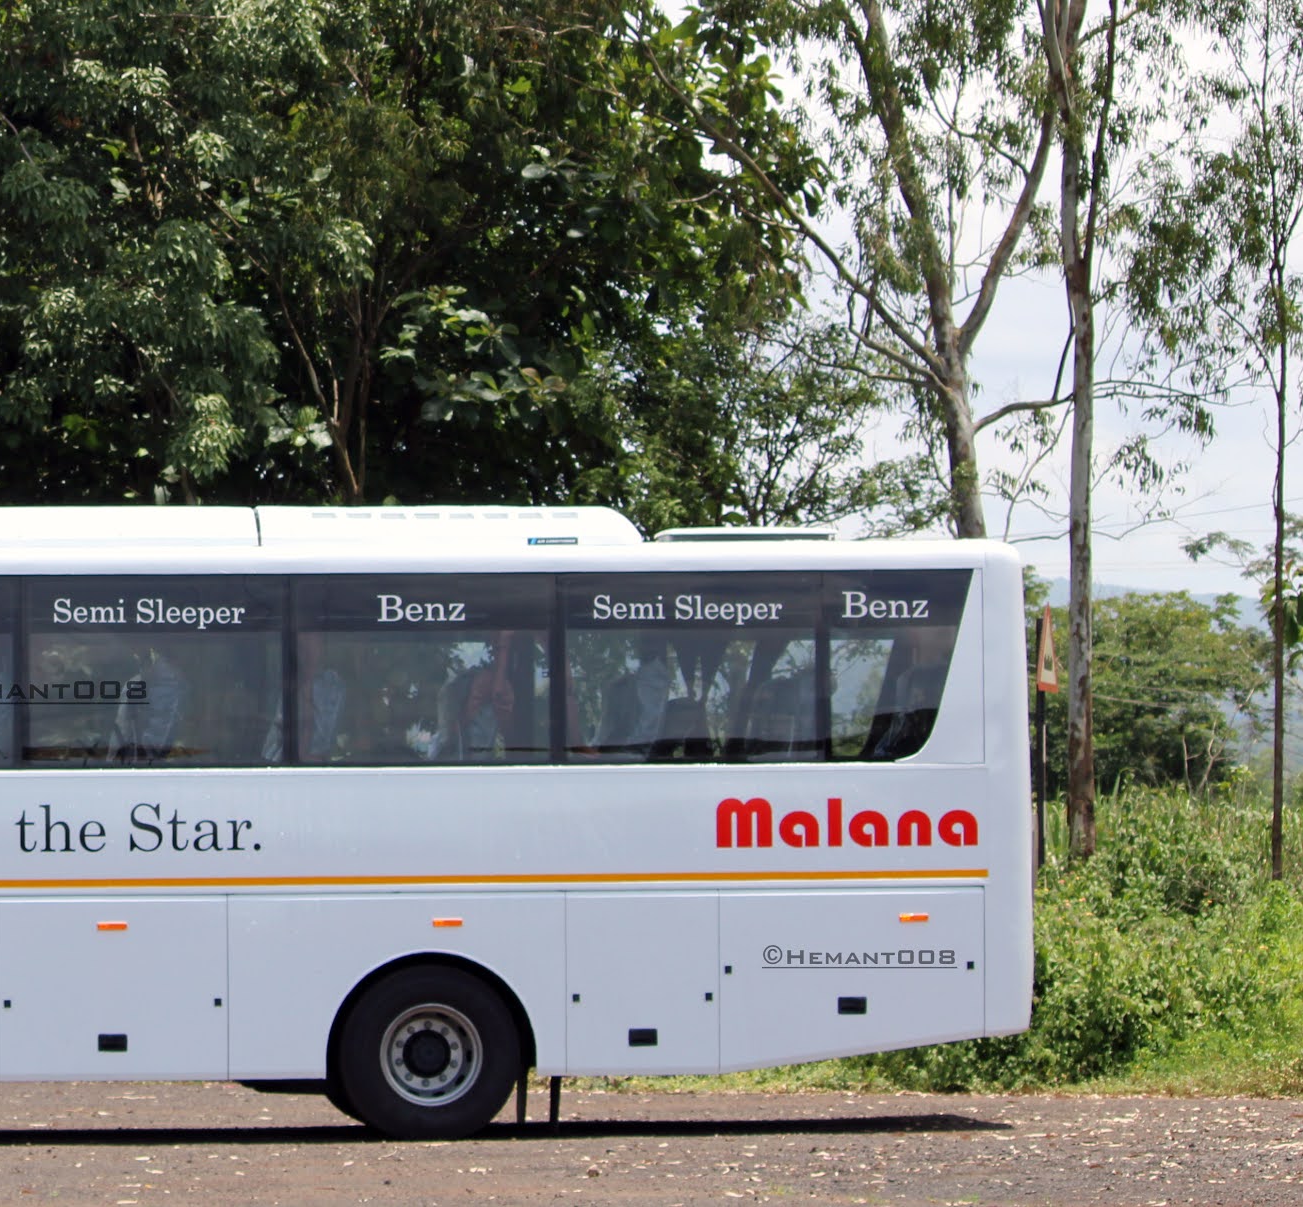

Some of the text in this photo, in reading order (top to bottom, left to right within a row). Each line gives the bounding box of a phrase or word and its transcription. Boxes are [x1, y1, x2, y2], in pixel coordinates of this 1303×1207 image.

[53, 598, 246, 630] Semi Sleeper
[376, 594, 466, 623] Benz
[593, 594, 783, 626] Semi Sleeper
[841, 591, 930, 619] Benz
[15, 804, 106, 853] the
[129, 803, 262, 852] Star.
[715, 797, 979, 848] Malana
